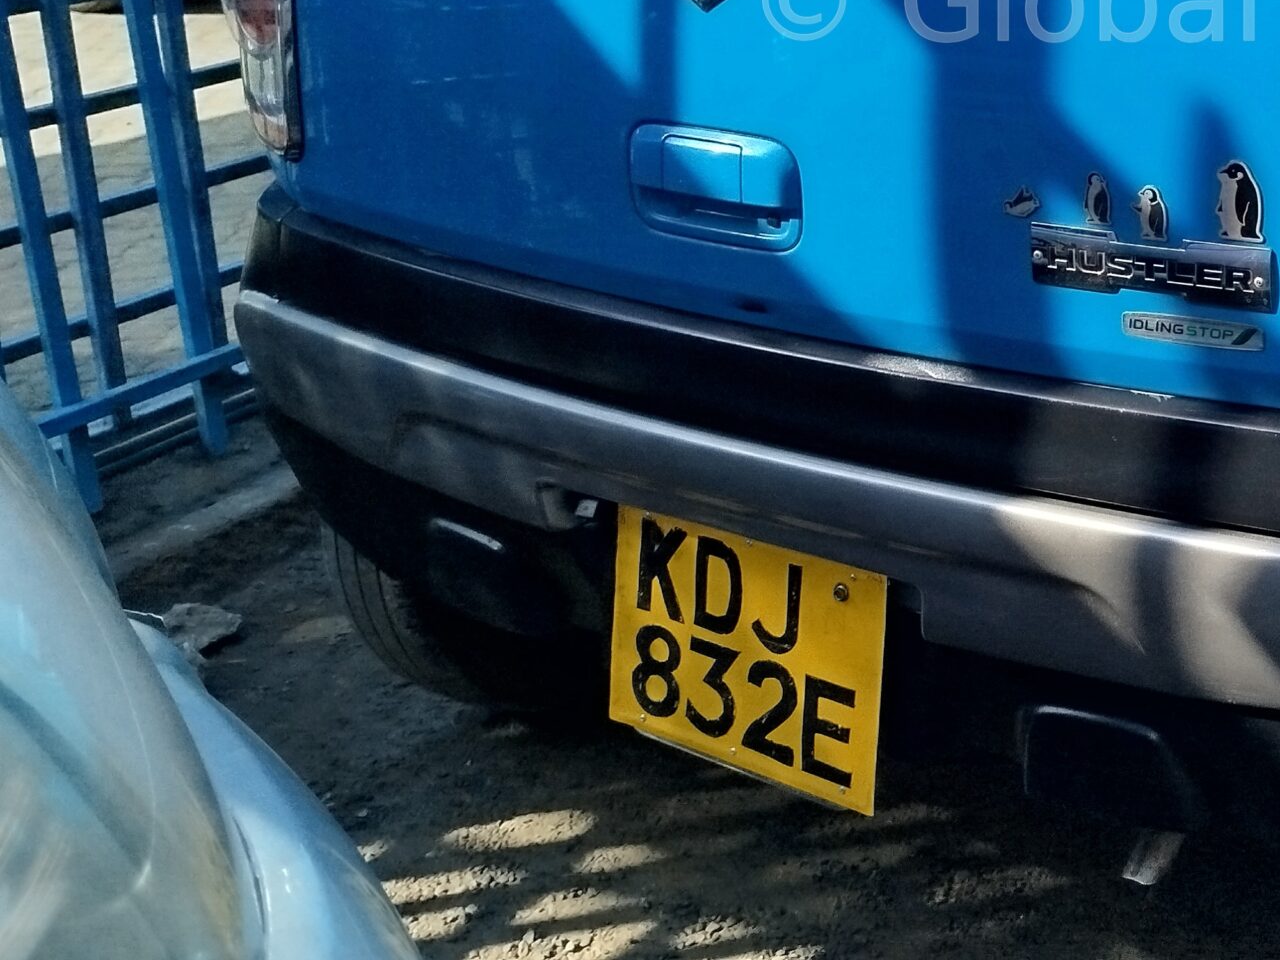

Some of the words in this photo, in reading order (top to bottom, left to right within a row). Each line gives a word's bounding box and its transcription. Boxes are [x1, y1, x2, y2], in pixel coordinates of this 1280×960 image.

[1047, 245, 1255, 293] HUSTLER
[637, 516, 803, 654] KDJ
[632, 624, 856, 789] 832E
